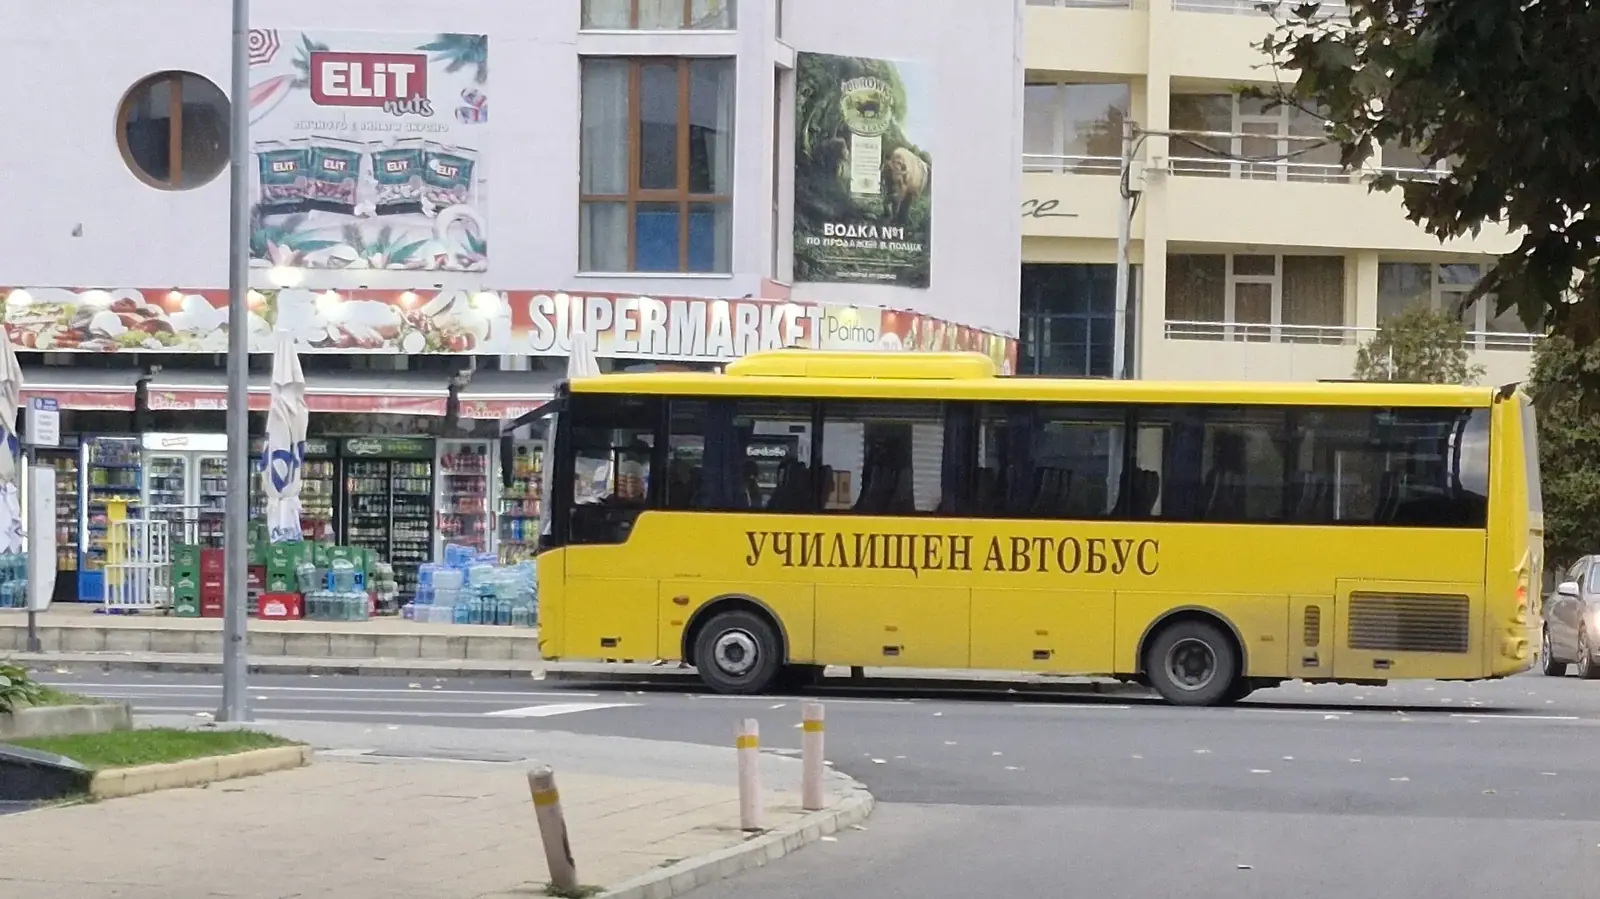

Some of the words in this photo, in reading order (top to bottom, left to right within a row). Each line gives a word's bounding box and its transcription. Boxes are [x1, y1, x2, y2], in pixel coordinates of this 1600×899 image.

[383, 93, 434, 117] nuts
[807, 237, 821, 246] ПО
[879, 241, 888, 249] В
[889, 242, 922, 252] ПОЛША
[824, 223, 878, 239] ВОДКА
[882, 226, 905, 240] №1
[528, 294, 824, 358] SUPERMARKET
[828, 315, 876, 343] Palma
[745, 531, 974, 578] УЧИЛИЩЕН
[983, 536, 1160, 576] АВТОБУС
